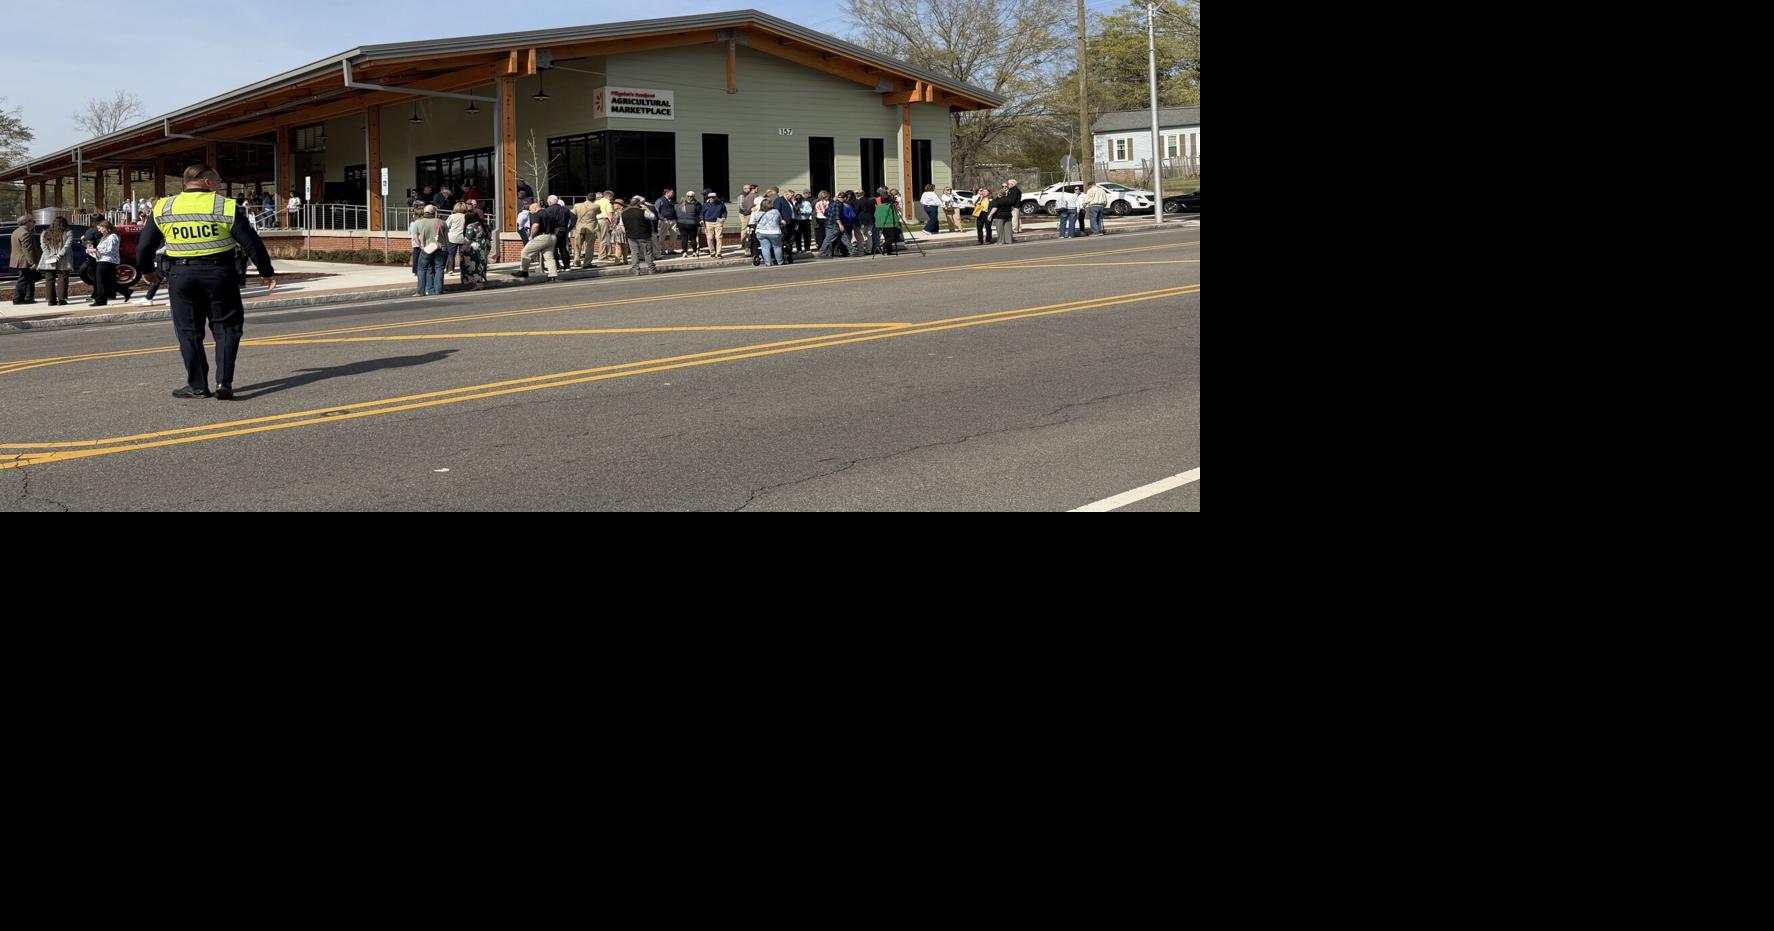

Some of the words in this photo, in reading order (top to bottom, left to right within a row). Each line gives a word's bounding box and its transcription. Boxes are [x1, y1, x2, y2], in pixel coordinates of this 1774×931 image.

[611, 97, 671, 107] AGRICULTURAL
[611, 106, 672, 115] MARKETPLACE
[172, 224, 219, 239] POLICE
